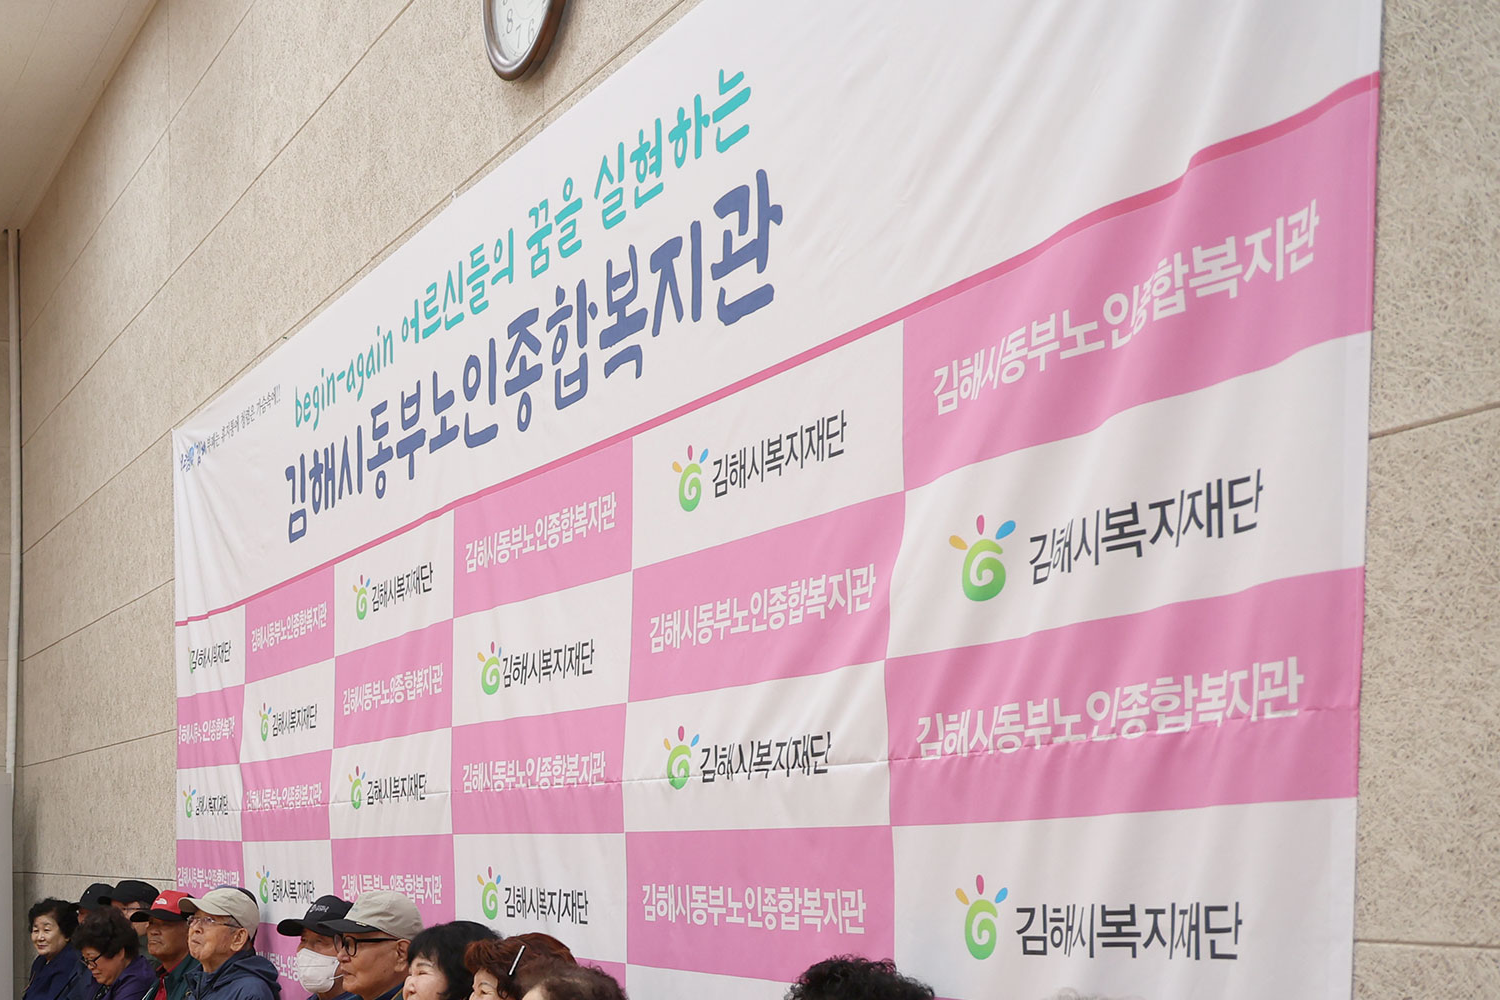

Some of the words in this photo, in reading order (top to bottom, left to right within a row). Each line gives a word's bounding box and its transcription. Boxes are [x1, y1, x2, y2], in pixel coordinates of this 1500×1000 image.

[506, 8, 513, 34] 8
[295, 325, 393, 431] begin-again
[401, 228, 514, 343] 어르신들의
[526, 177, 583, 279] 꿈을
[594, 68, 751, 230] 실현하는
[933, 198, 1320, 416] 김해시동부노인종합복지관
[285, 169, 783, 543] 김해시동부노인종합복지관
[712, 409, 847, 498] 김해시복지재단
[465, 491, 617, 573] 김해시동부노인종합복지관
[1029, 468, 1264, 585] 김해시복지재단
[371, 561, 433, 613] 김해시복지재단
[650, 564, 876, 654] 김해시동부노인종합복지관
[251, 601, 327, 652] 김해시동부노인종합복지관
[502, 638, 595, 688] 김해시복지재단
[343, 663, 443, 716] 김해시동부노인종합복지관
[916, 656, 1303, 760] 김해시동부노인종합복지관
[272, 703, 318, 737] 김해시복지재단
[462, 751, 606, 793] 김해시동부노인종합복지관
[700, 731, 831, 783] 김해시복지재단
[367, 772, 427, 805] 김해시복지재단
[271, 879, 315, 904] 김해시복지재단
[504, 885, 589, 925] 김해시복지재단
[642, 883, 866, 935] 김해시동부노인종합복지관
[1016, 901, 1242, 960] 김해시복지재단
